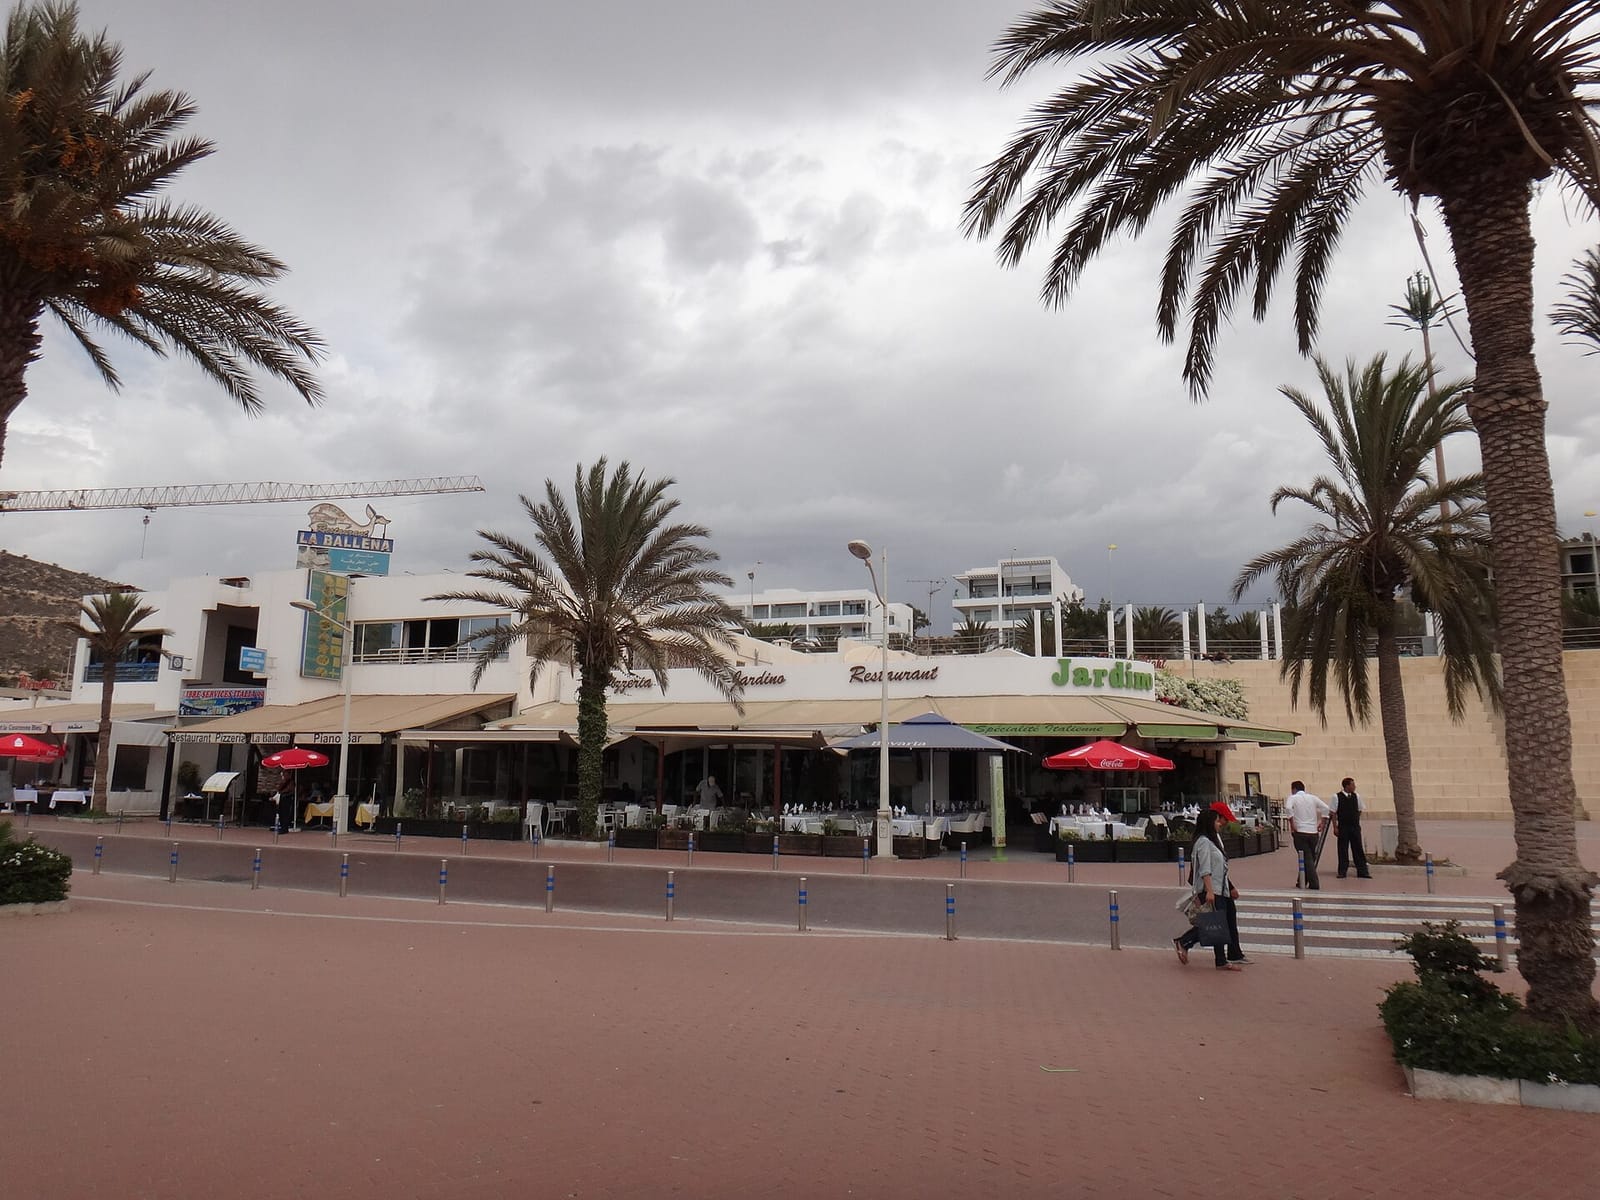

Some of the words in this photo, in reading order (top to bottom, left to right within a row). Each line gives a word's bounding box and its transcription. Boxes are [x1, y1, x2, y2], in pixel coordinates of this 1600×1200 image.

[300, 533, 318, 545] LA
[323, 534, 390, 552] BALLENA
[607, 672, 653, 695] izzeria
[169, 732, 212, 743] Restaurant
[216, 732, 246, 744] Pizzeria
[251, 733, 260, 743] La
[262, 732, 291, 743] Ballena
[313, 733, 341, 744] Piano
